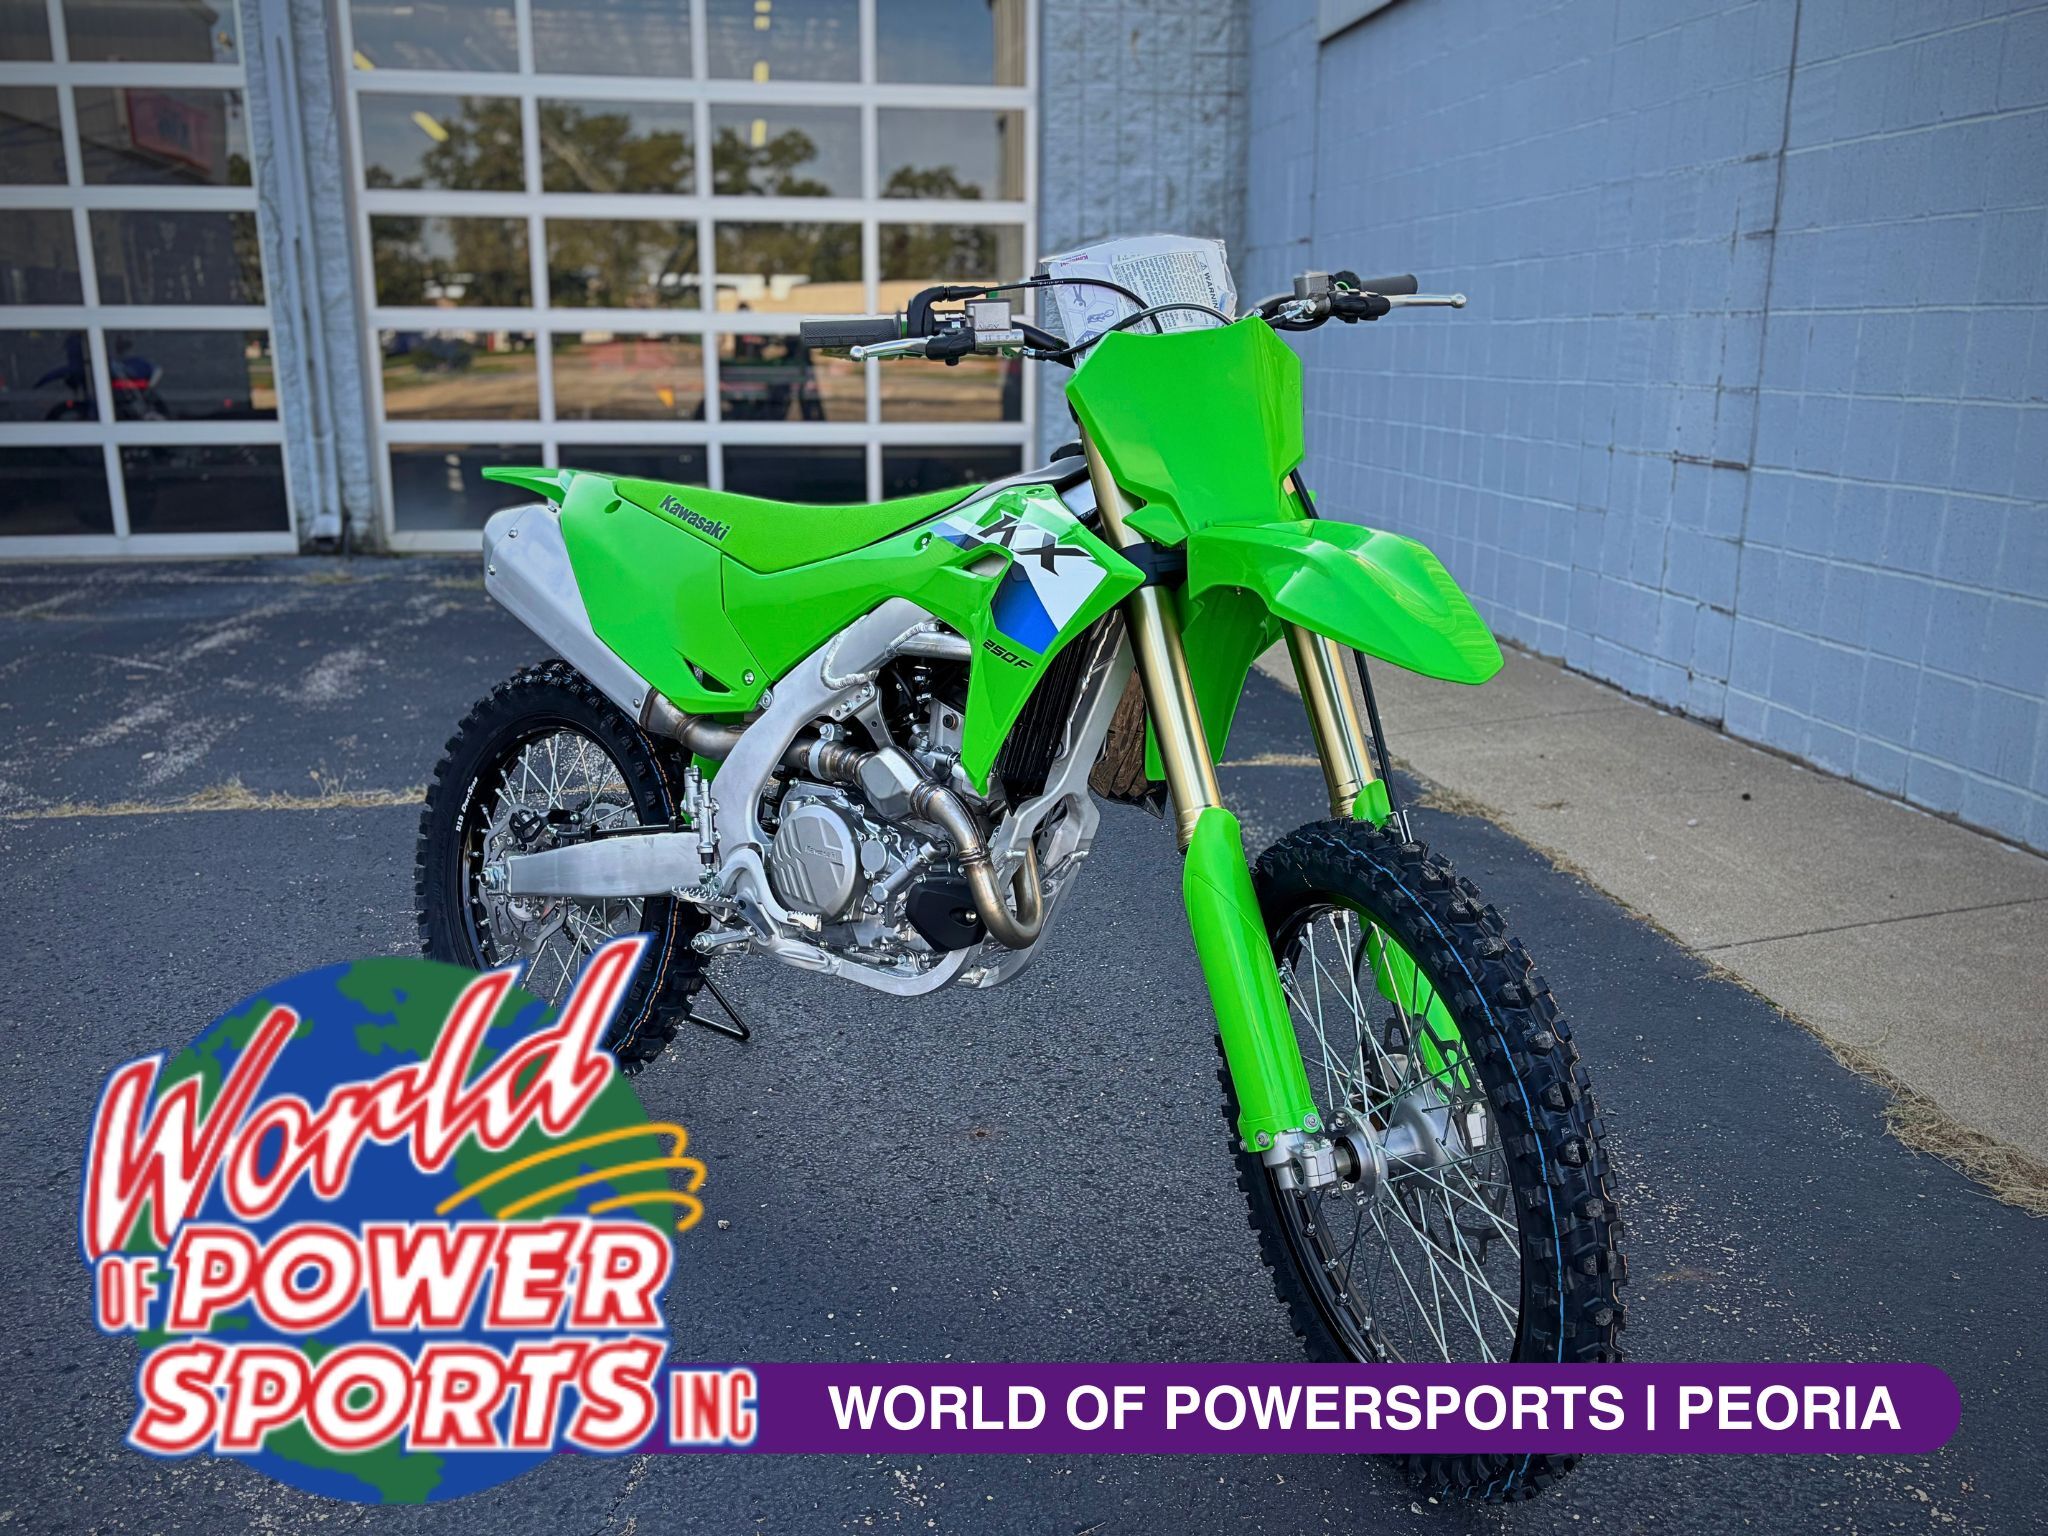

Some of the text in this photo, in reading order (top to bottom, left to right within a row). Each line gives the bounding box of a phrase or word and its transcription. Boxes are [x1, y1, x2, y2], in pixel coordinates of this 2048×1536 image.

[1204, 272, 1220, 310] WARNIN
[659, 494, 731, 541] Kawasaki
[977, 513, 1093, 577] KX
[982, 638, 1035, 670] 250F
